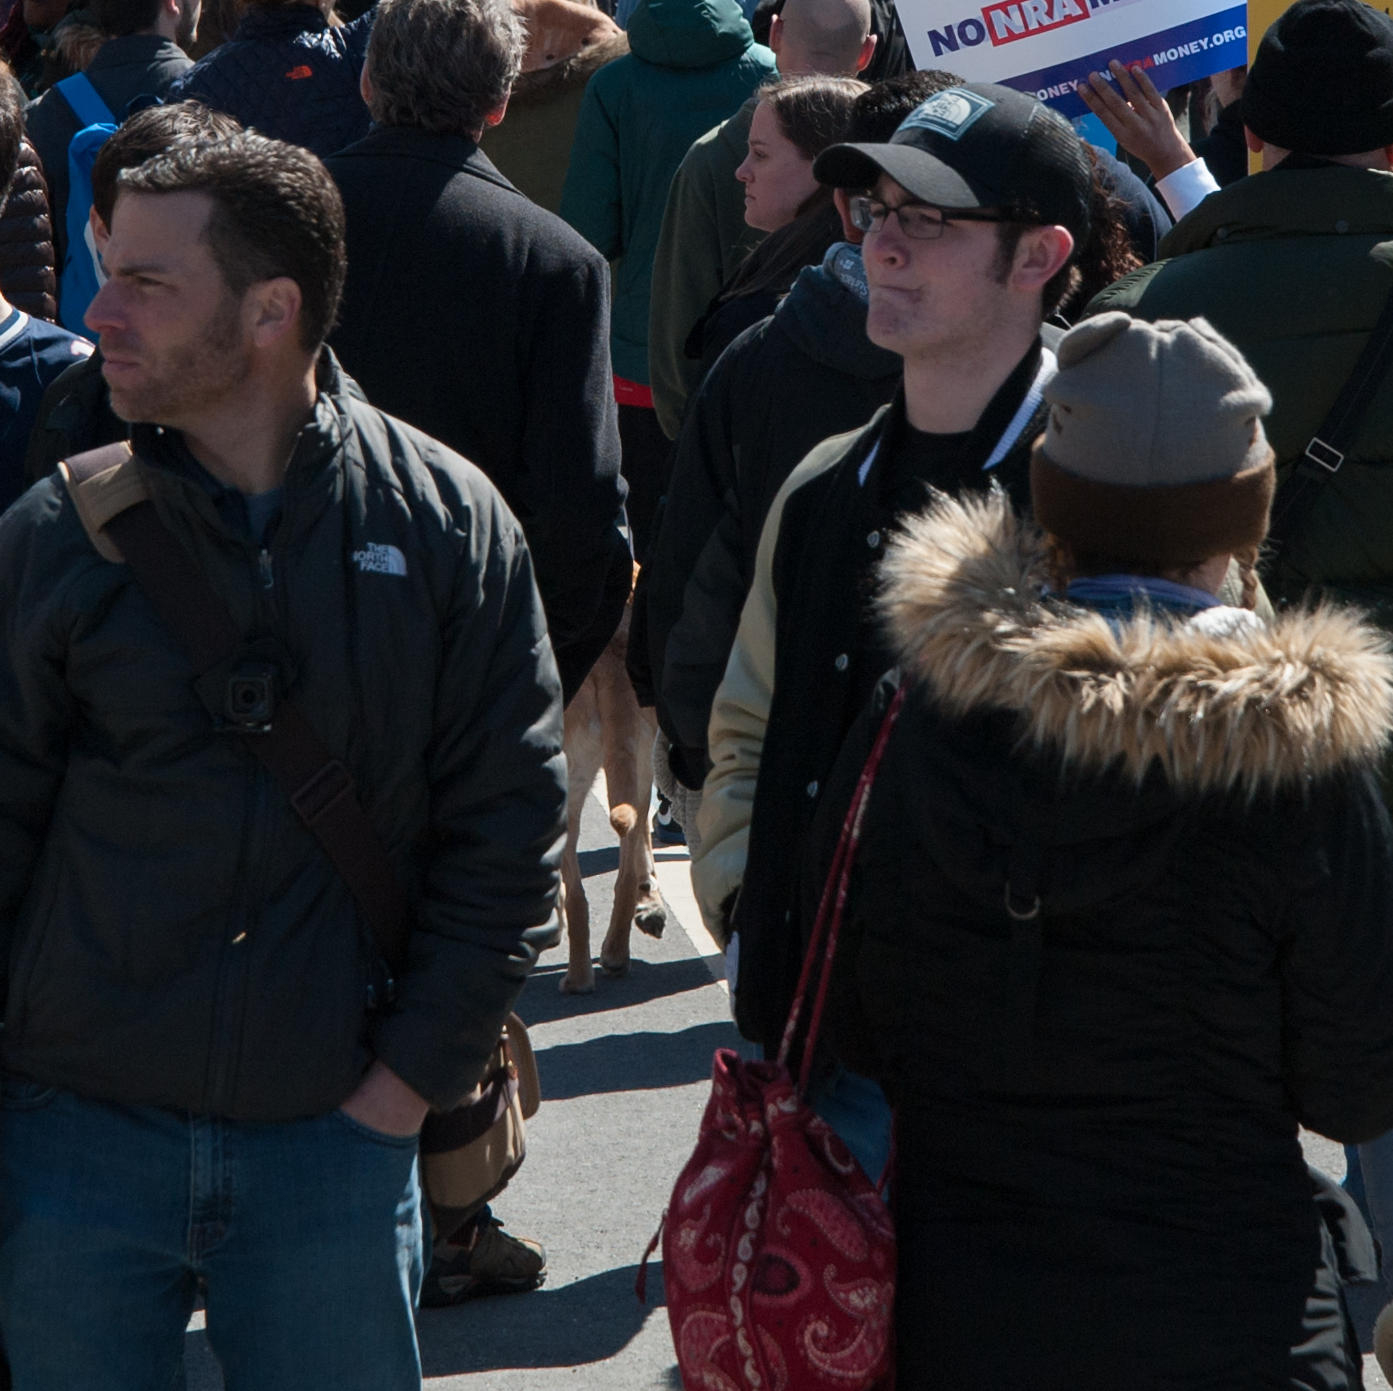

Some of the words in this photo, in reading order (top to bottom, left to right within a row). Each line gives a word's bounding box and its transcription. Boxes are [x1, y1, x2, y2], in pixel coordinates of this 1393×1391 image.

[1031, 78, 1080, 102] ONEY
[367, 542, 389, 552] THE
[360, 560, 389, 573] FACE
